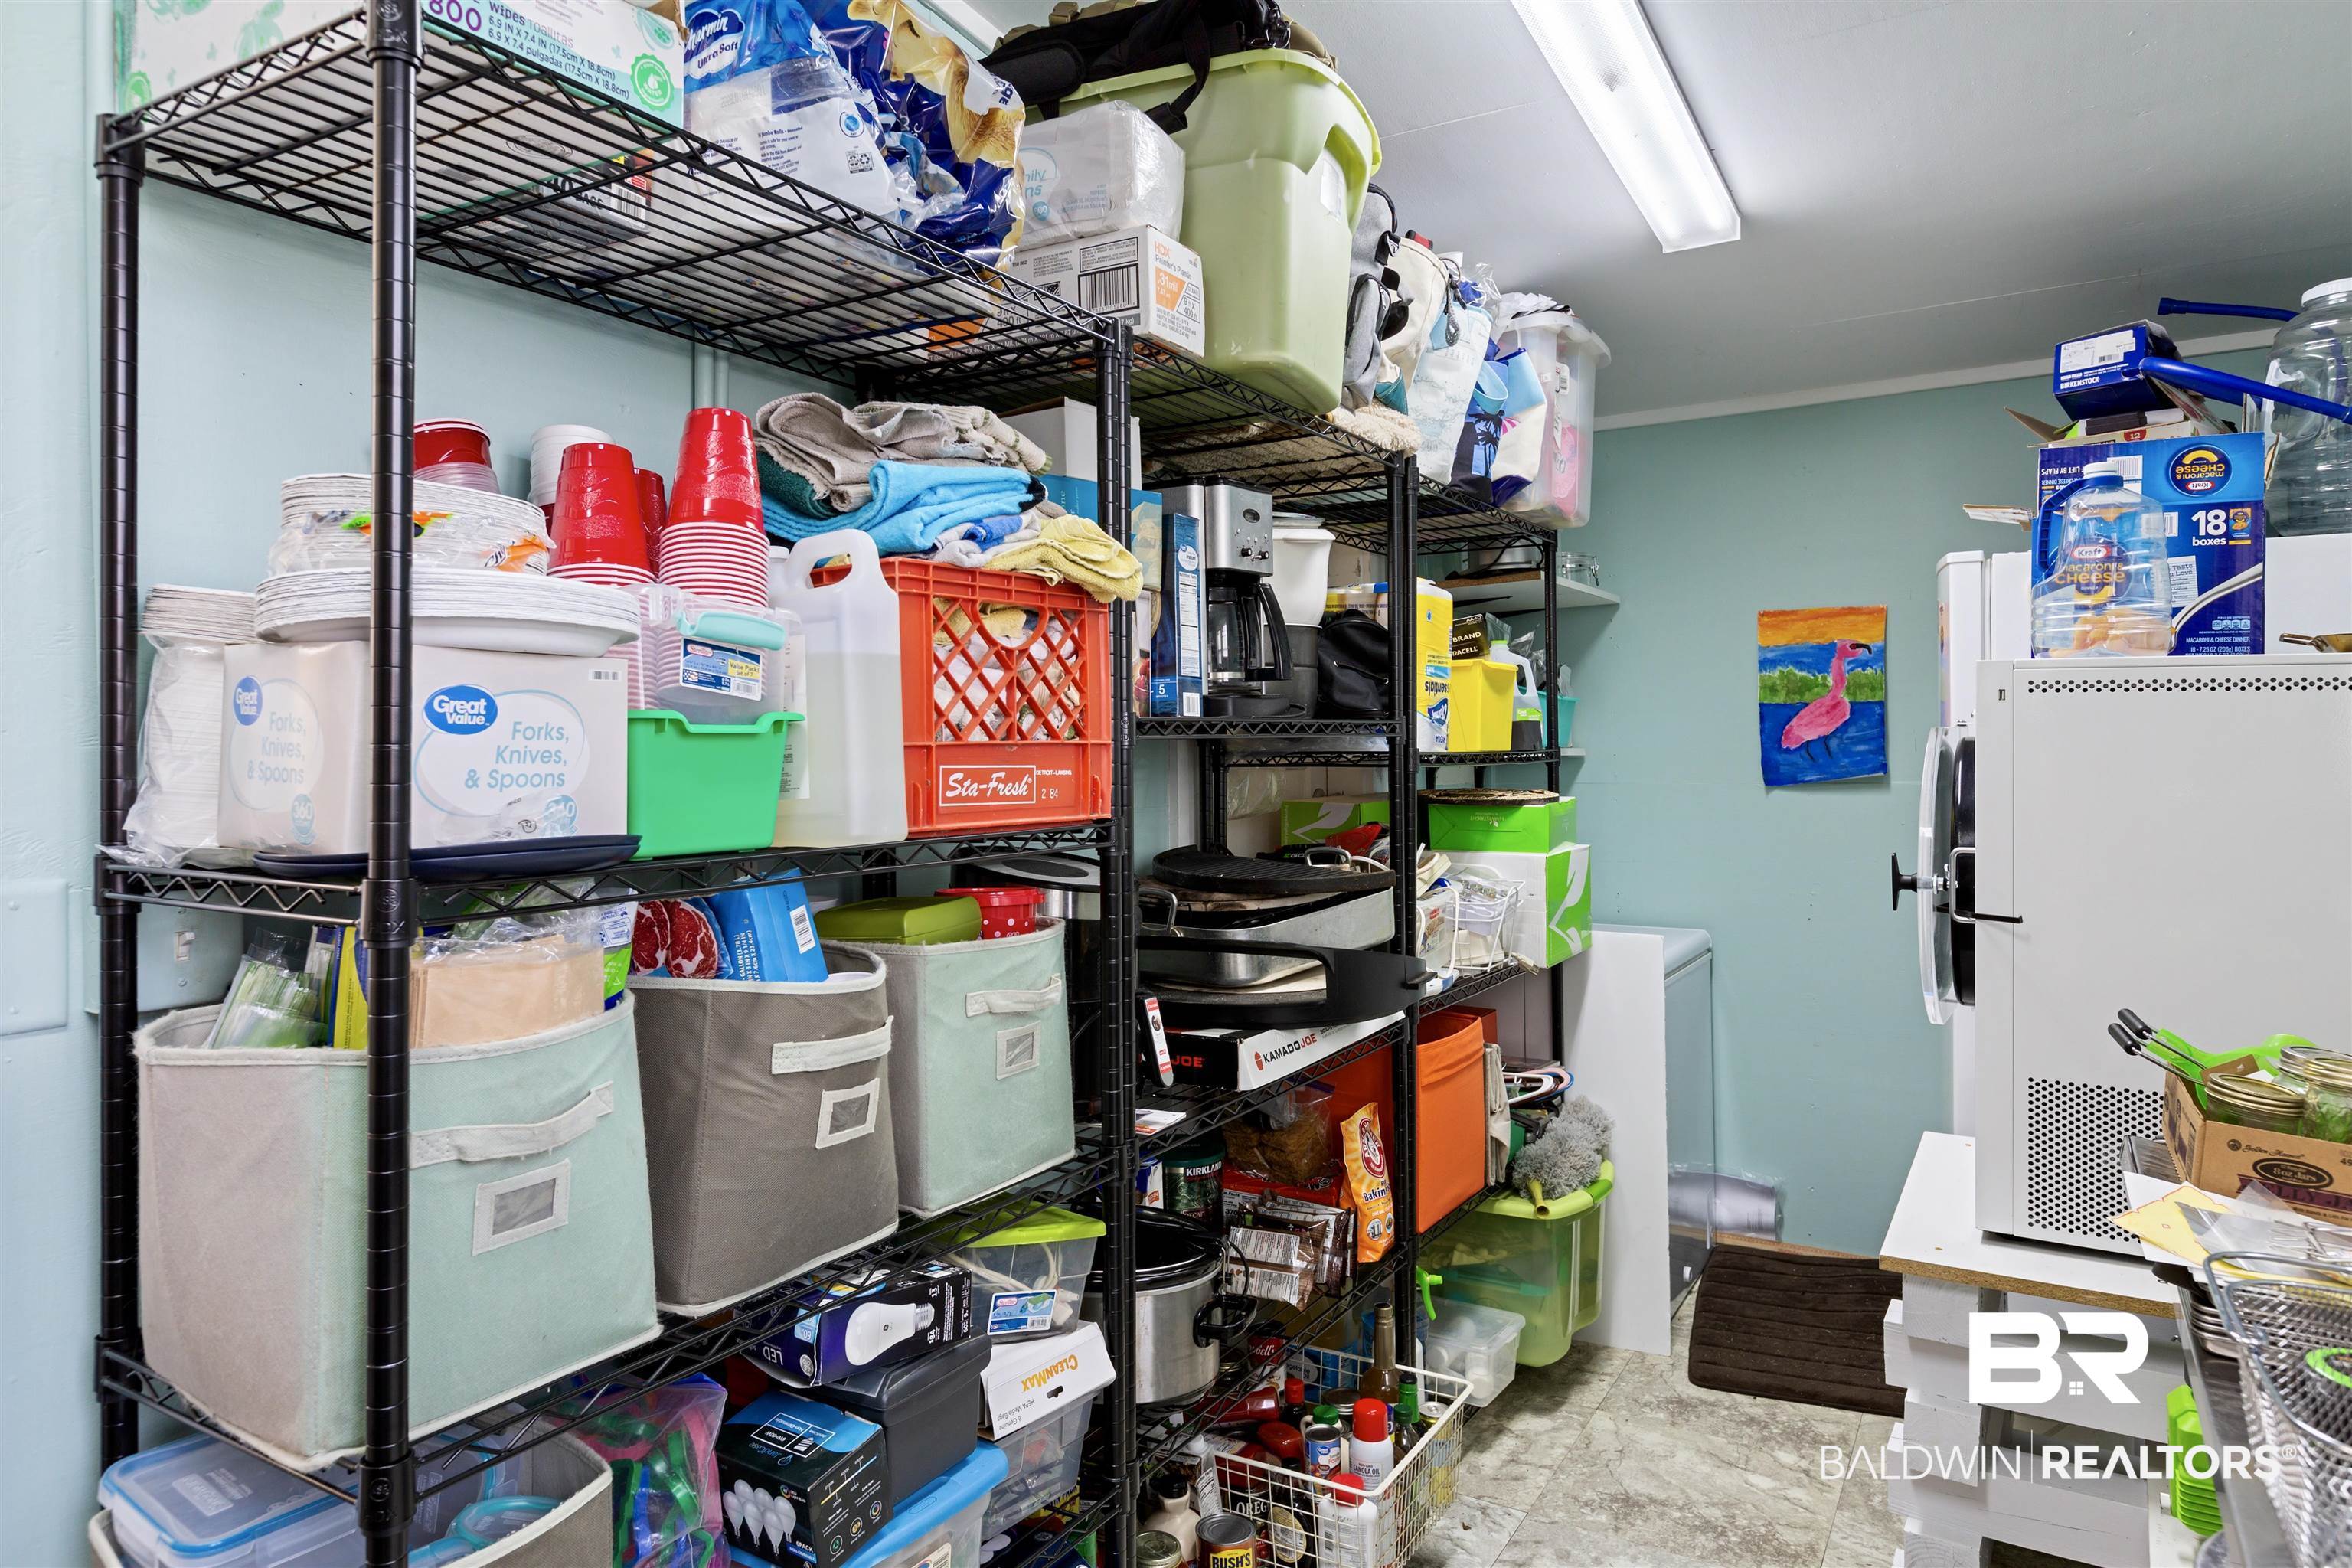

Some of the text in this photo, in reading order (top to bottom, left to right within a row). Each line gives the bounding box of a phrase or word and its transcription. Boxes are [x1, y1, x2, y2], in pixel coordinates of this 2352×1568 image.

[489, 2, 525, 26] Wipes
[684, 15, 729, 51] harmin
[488, 15, 502, 29] 6.9
[505, 23, 513, 33] IN
[516, 28, 522, 38] X
[525, 31, 535, 43] 7.4
[538, 38, 547, 49] IN
[580, 56, 586, 67] X
[720, 41, 738, 55] Soft
[488, 28, 501, 41] 6.9
[505, 34, 511, 45] X
[513, 38, 524, 51] 7.4
[526, 46, 563, 69] pulgadas
[595, 75, 601, 87] X
[2060, 376, 2100, 390] BIRKENSTOCK
[2041, 466, 2081, 476] LIFT BY FLAPS
[2183, 472, 2224, 480] macaroni
[2190, 509, 2227, 537] 18
[2192, 537, 2226, 547] boxes
[2077, 547, 2102, 557] Kraft
[2171, 563, 2194, 572] Taste
[1452, 631, 1482, 643] BRAND
[730, 661, 744, 670] Value
[236, 688, 258, 705] Great
[1158, 684, 1166, 695] 5
[240, 703, 258, 716] Value
[433, 695, 487, 715] Great
[269, 711, 307, 737] Forks,
[446, 712, 486, 726] Value
[511, 720, 570, 743] Forks,
[261, 735, 305, 762] Knives,
[495, 744, 568, 766] Knives,
[247, 760, 305, 786] & Spoons
[464, 768, 566, 793] & Spoons
[1041, 788, 1059, 799] 2 84
[292, 802, 312, 820] 360
[737, 955, 746, 978] GALLON
[1171, 1055, 1204, 1068] JOE
[1186, 1161, 1222, 1177] KIRKLAND
[2294, 1172, 2318, 1183] Jars
[931, 1287, 938, 1298] 13
[763, 1345, 783, 1366] LED
[997, 1398, 1035, 1422] HEPA Media Bags
[998, 1419, 1018, 1431] Genuine
[1353, 1464, 1372, 1475] CANOLA
[795, 1540, 814, 1553] 6PACK
[1211, 1552, 1251, 1568] BUSH'S
